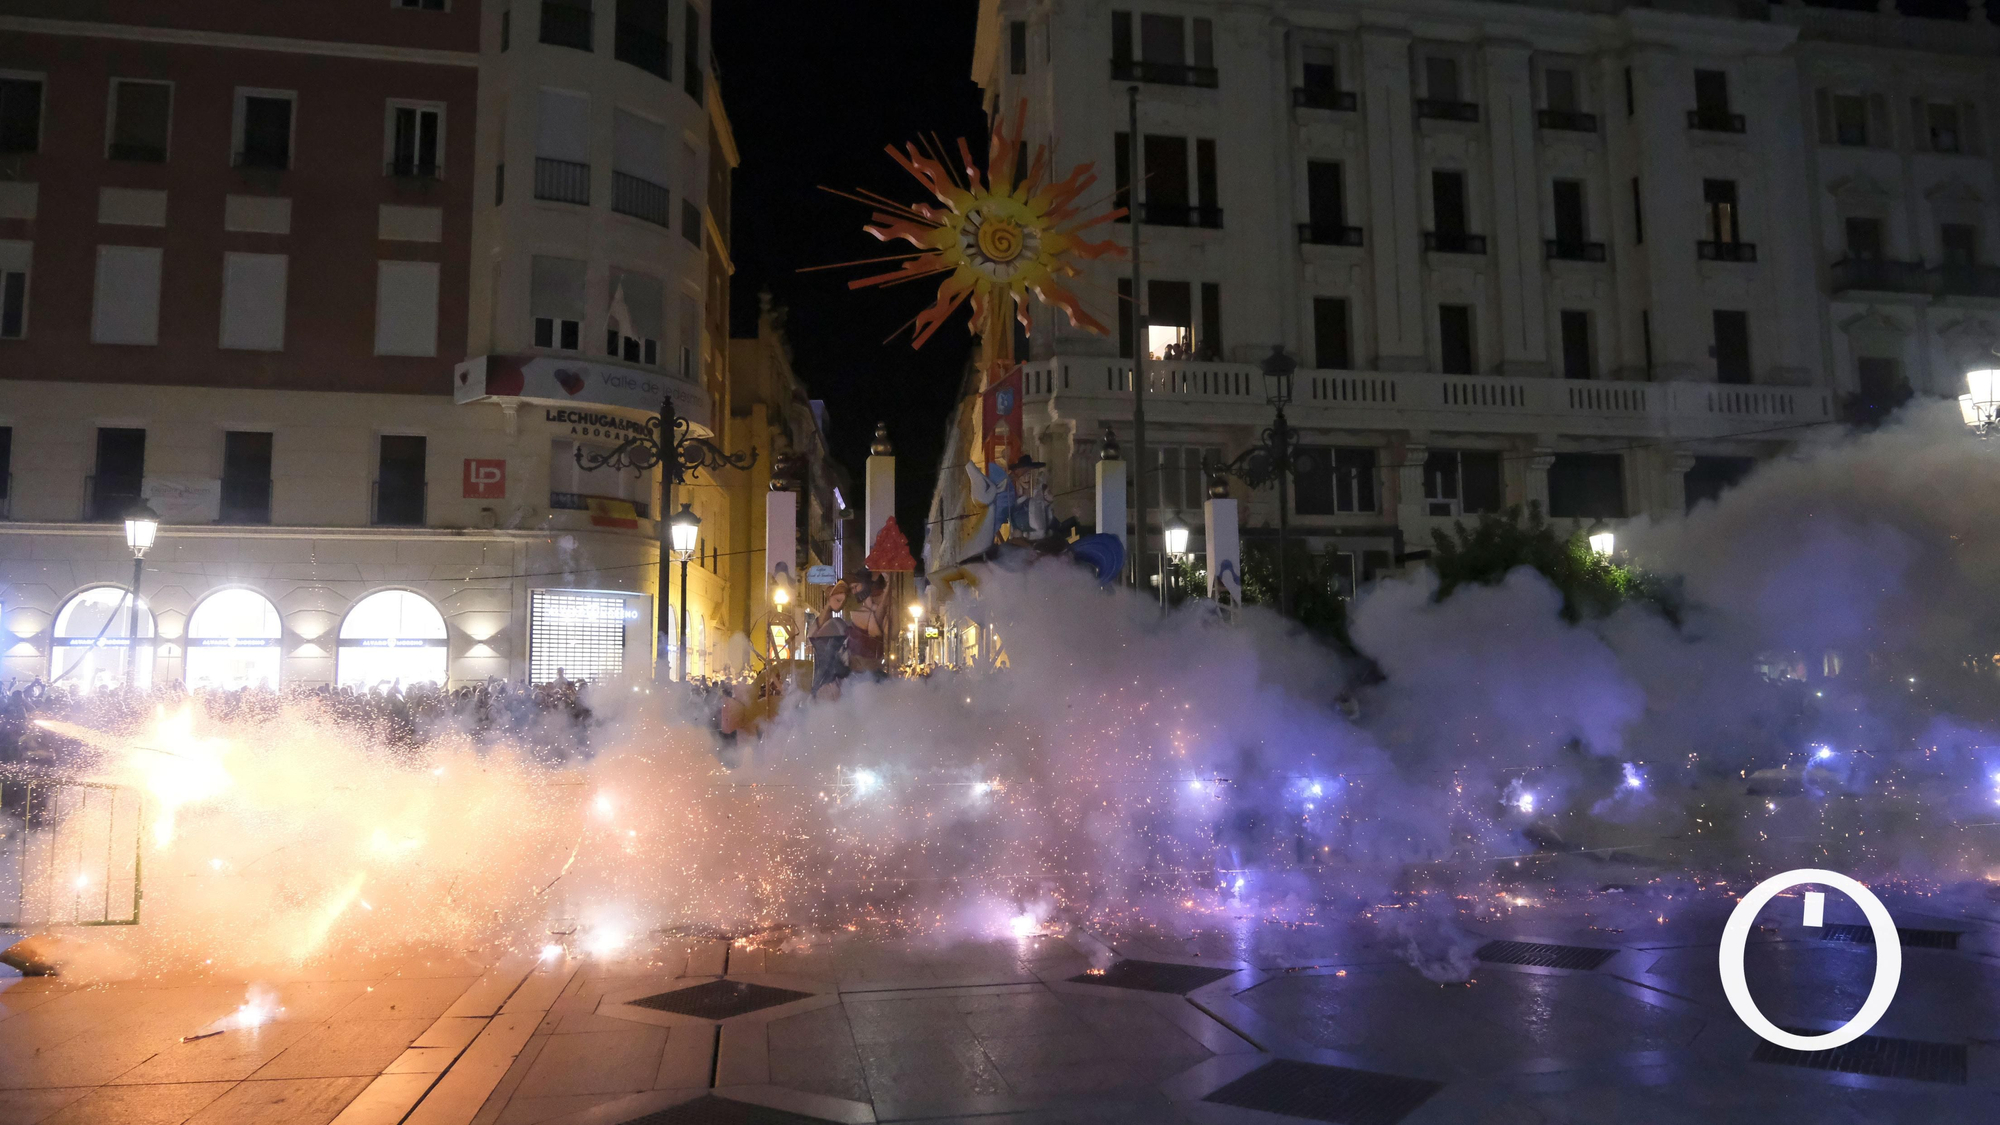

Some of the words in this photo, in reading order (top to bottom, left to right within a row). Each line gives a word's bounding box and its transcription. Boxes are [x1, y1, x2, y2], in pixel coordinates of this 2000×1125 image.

[600, 371, 637, 390] Valle
[641, 380, 659, 395] de
[571, 426, 643, 444] ABOGADO
[470, 461, 501, 493] LP
